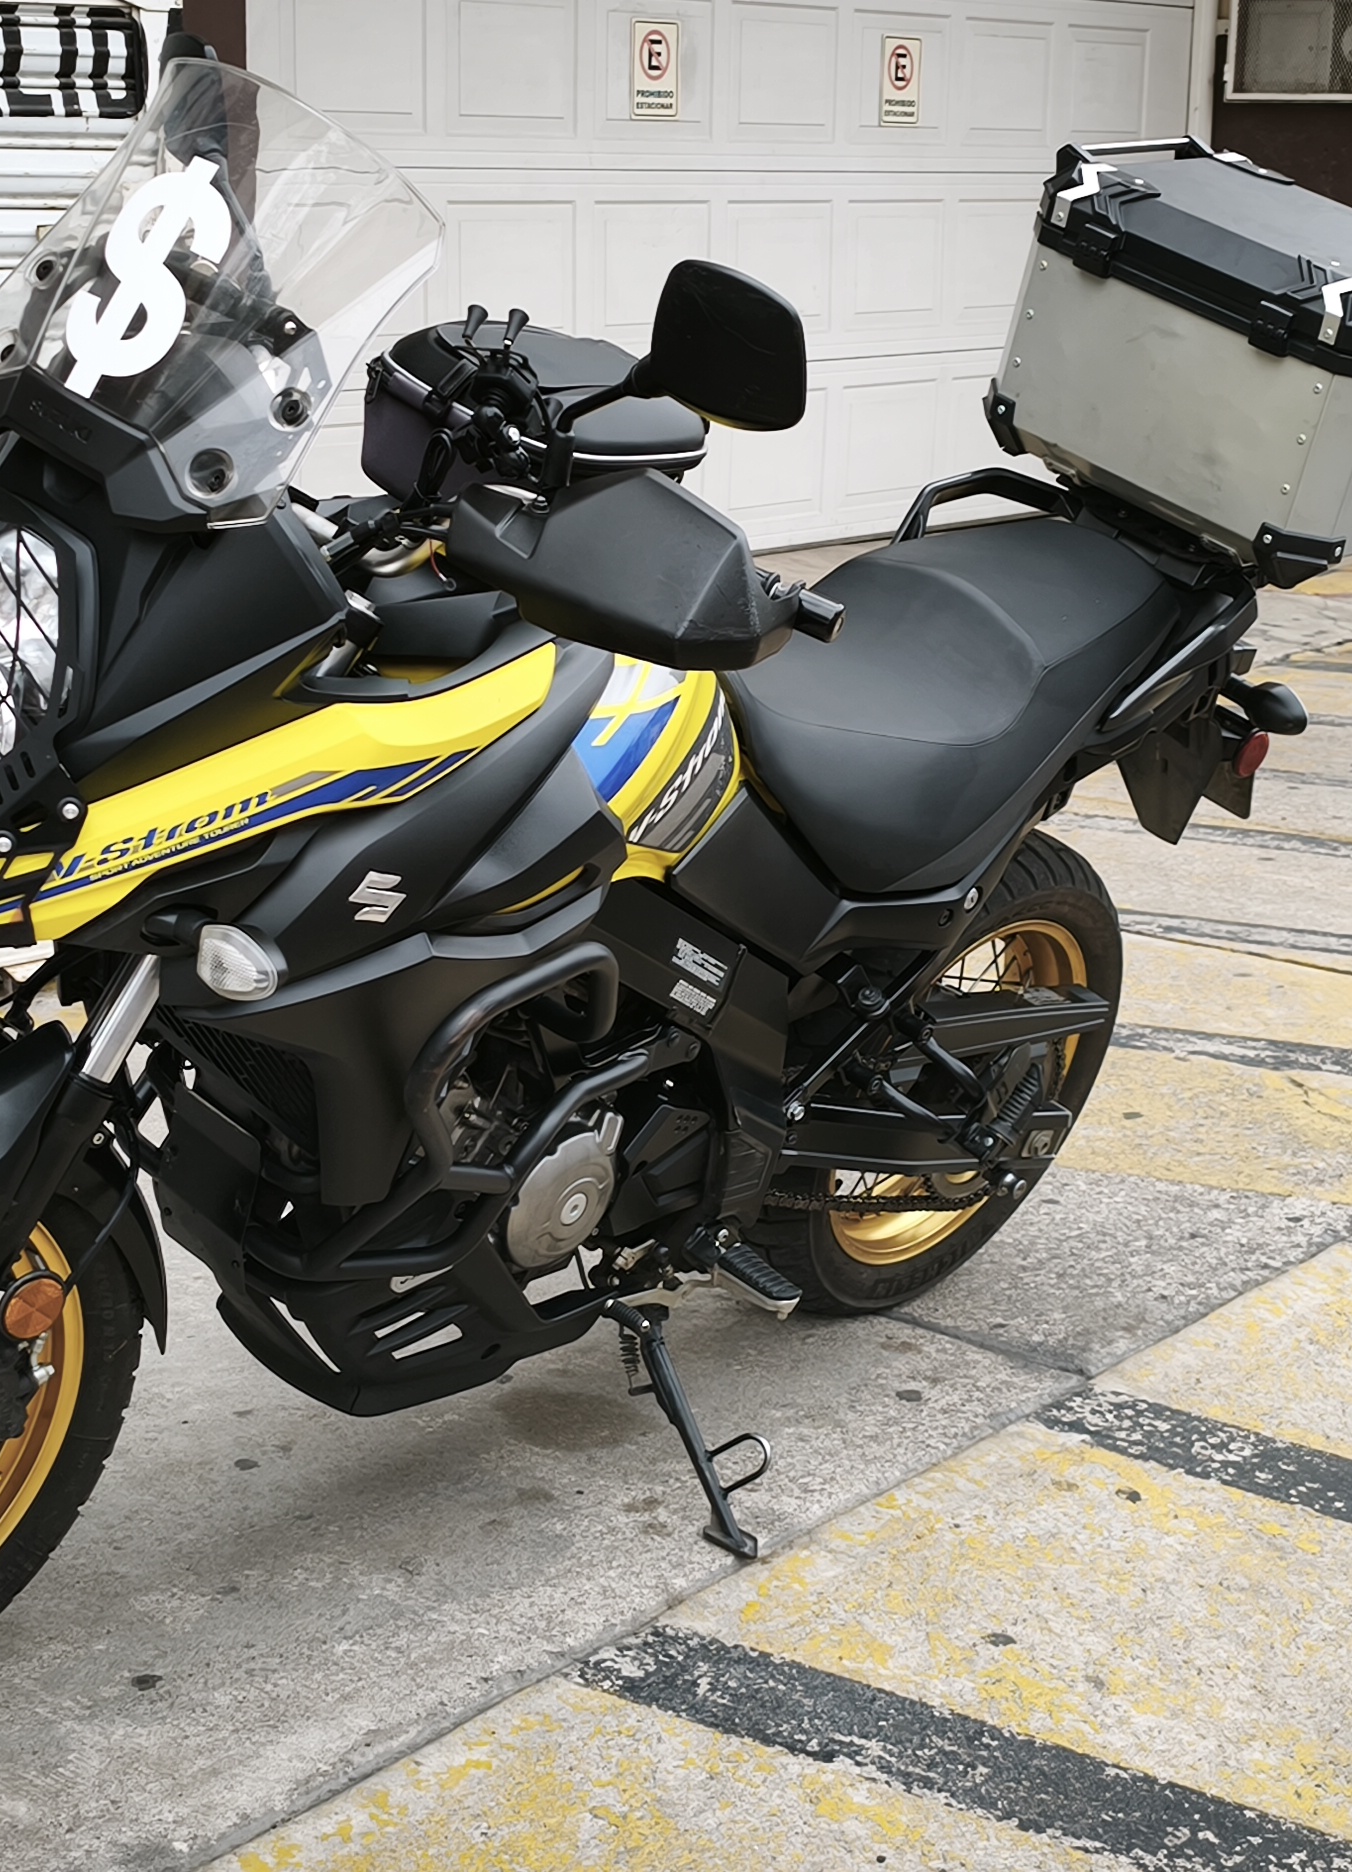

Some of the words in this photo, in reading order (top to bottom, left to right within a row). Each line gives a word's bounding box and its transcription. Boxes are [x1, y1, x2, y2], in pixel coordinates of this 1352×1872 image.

[636, 89, 674, 98] PROHIBIDO
[89, 863, 132, 882] SPORT
[131, 838, 203, 867] ADVENTURE
[204, 817, 250, 841] TOURER
